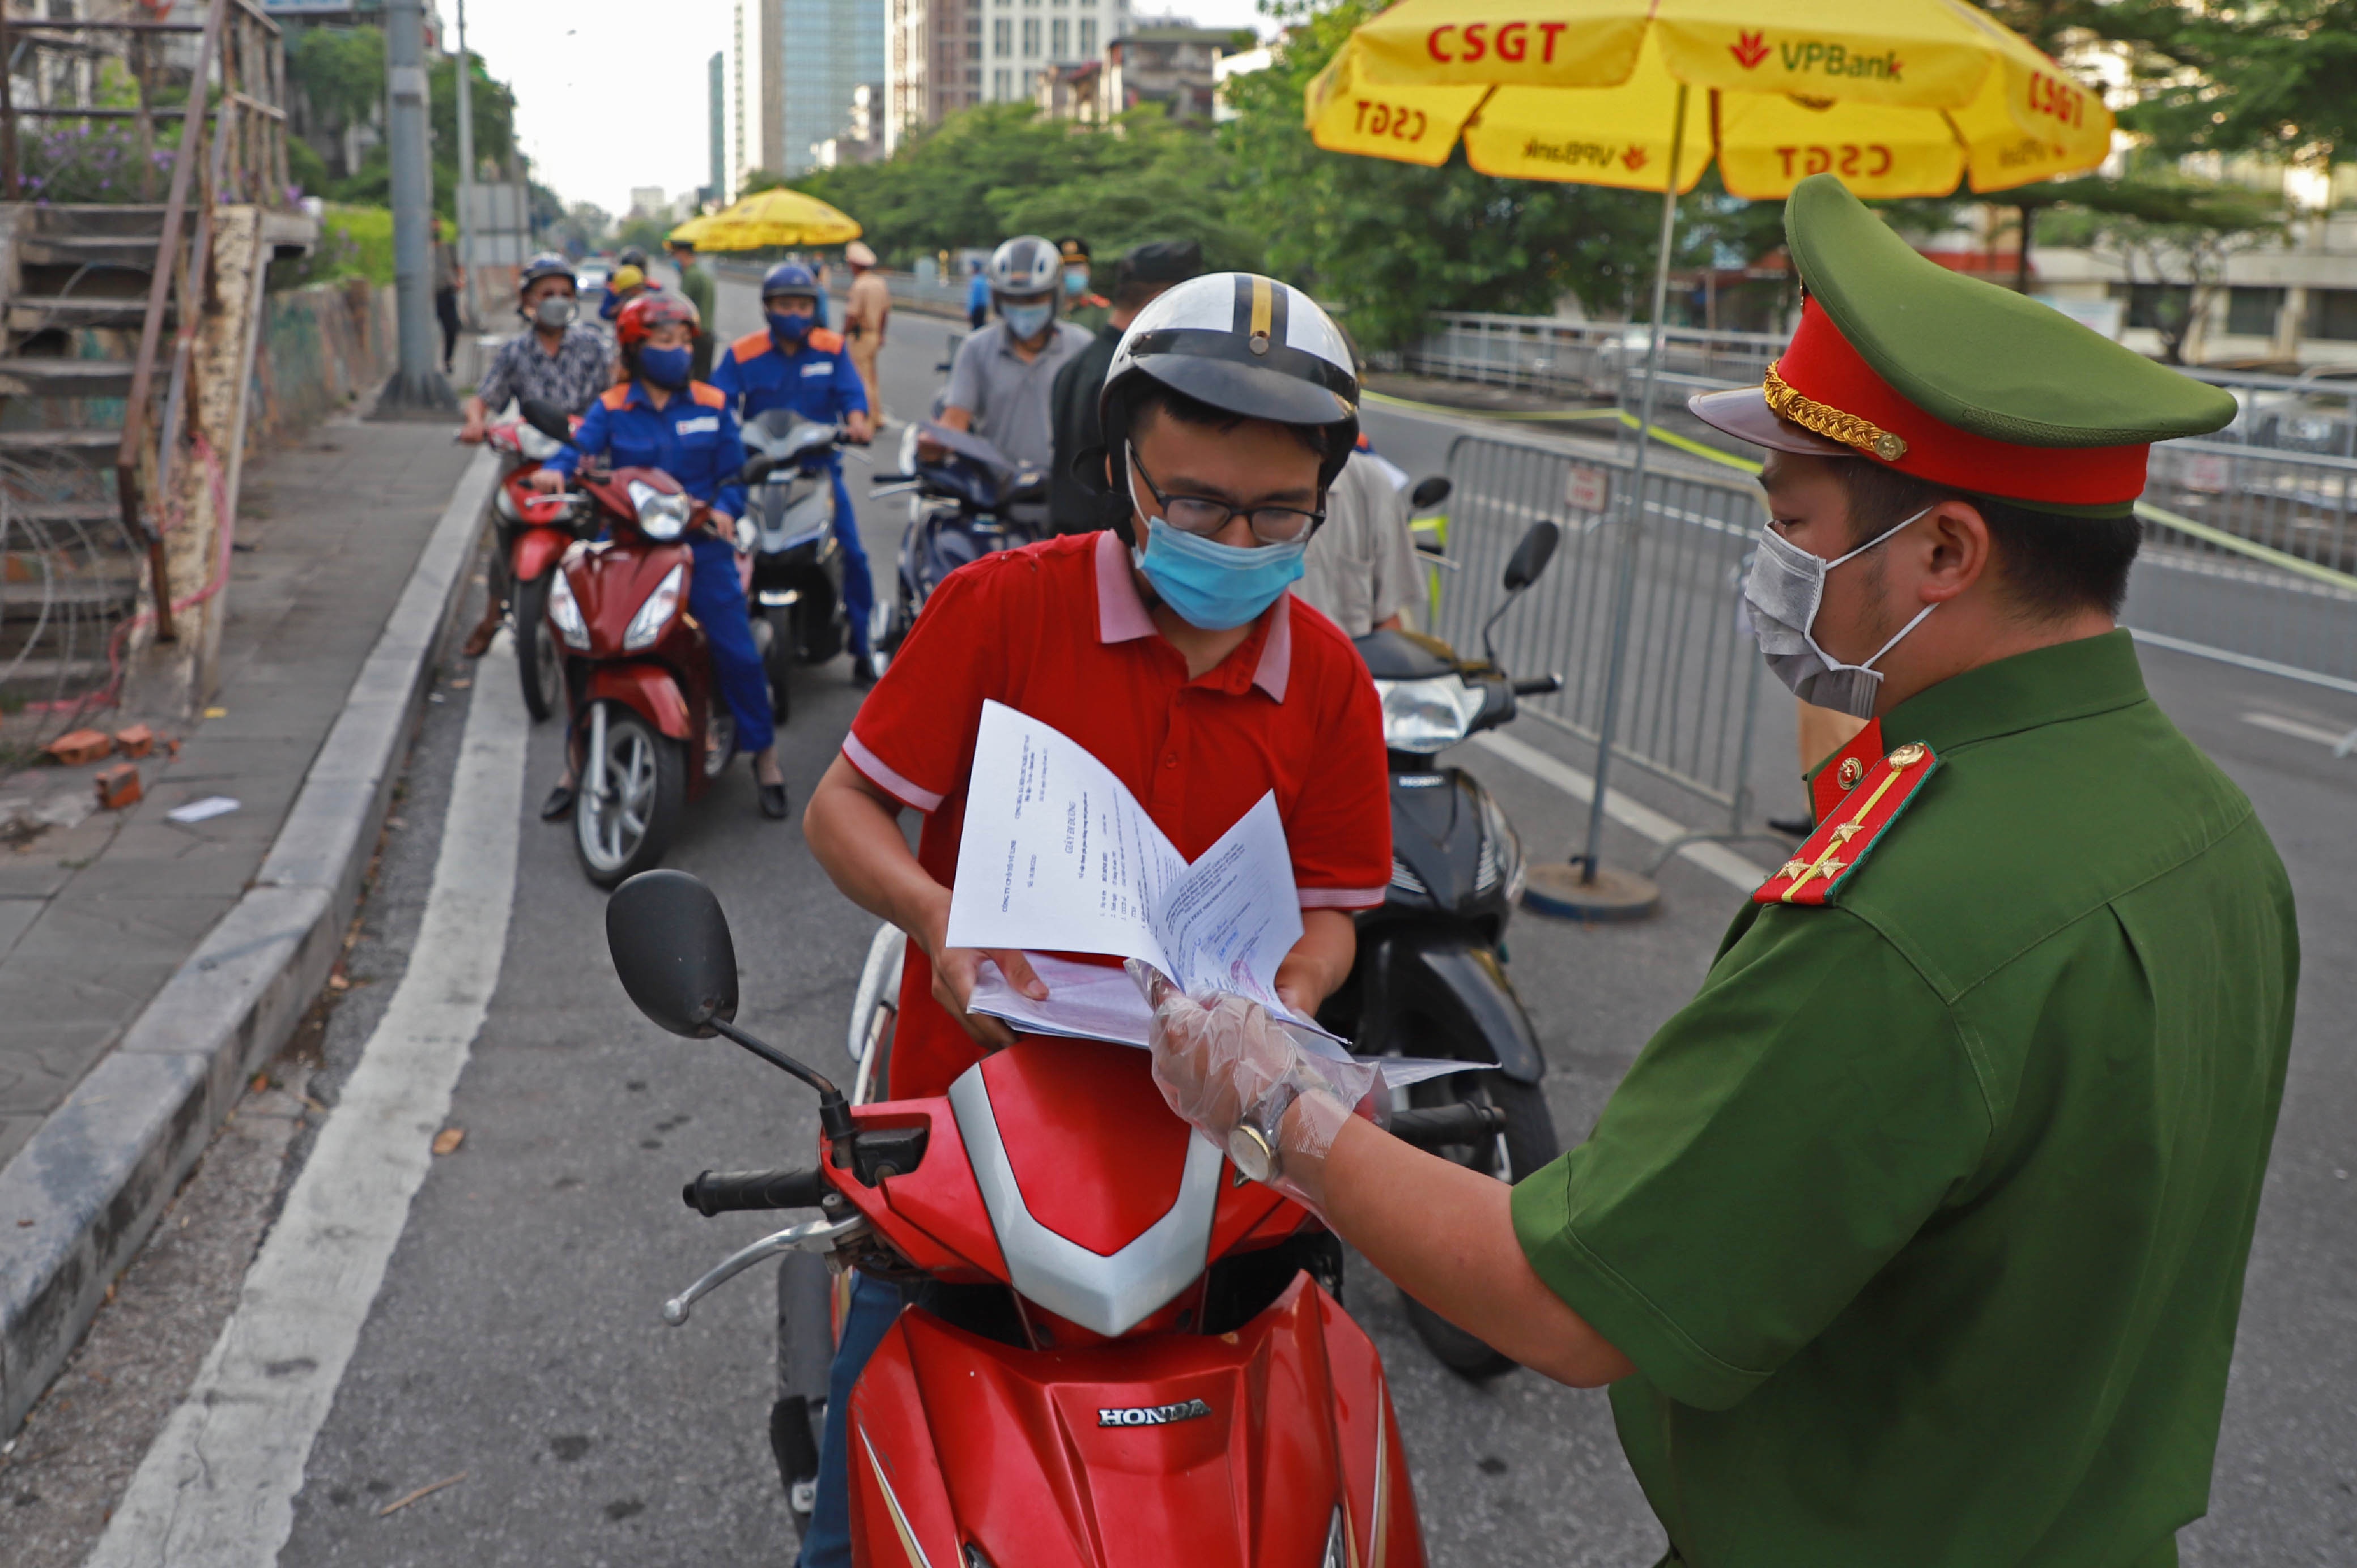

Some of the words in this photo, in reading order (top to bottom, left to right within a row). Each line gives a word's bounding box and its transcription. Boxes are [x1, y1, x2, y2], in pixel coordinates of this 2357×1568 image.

[1428, 21, 1568, 63] CSGT
[1780, 42, 1903, 83] VPBank
[2028, 71, 2083, 129] CSGT
[1098, 1399, 1211, 1426] HONDA
